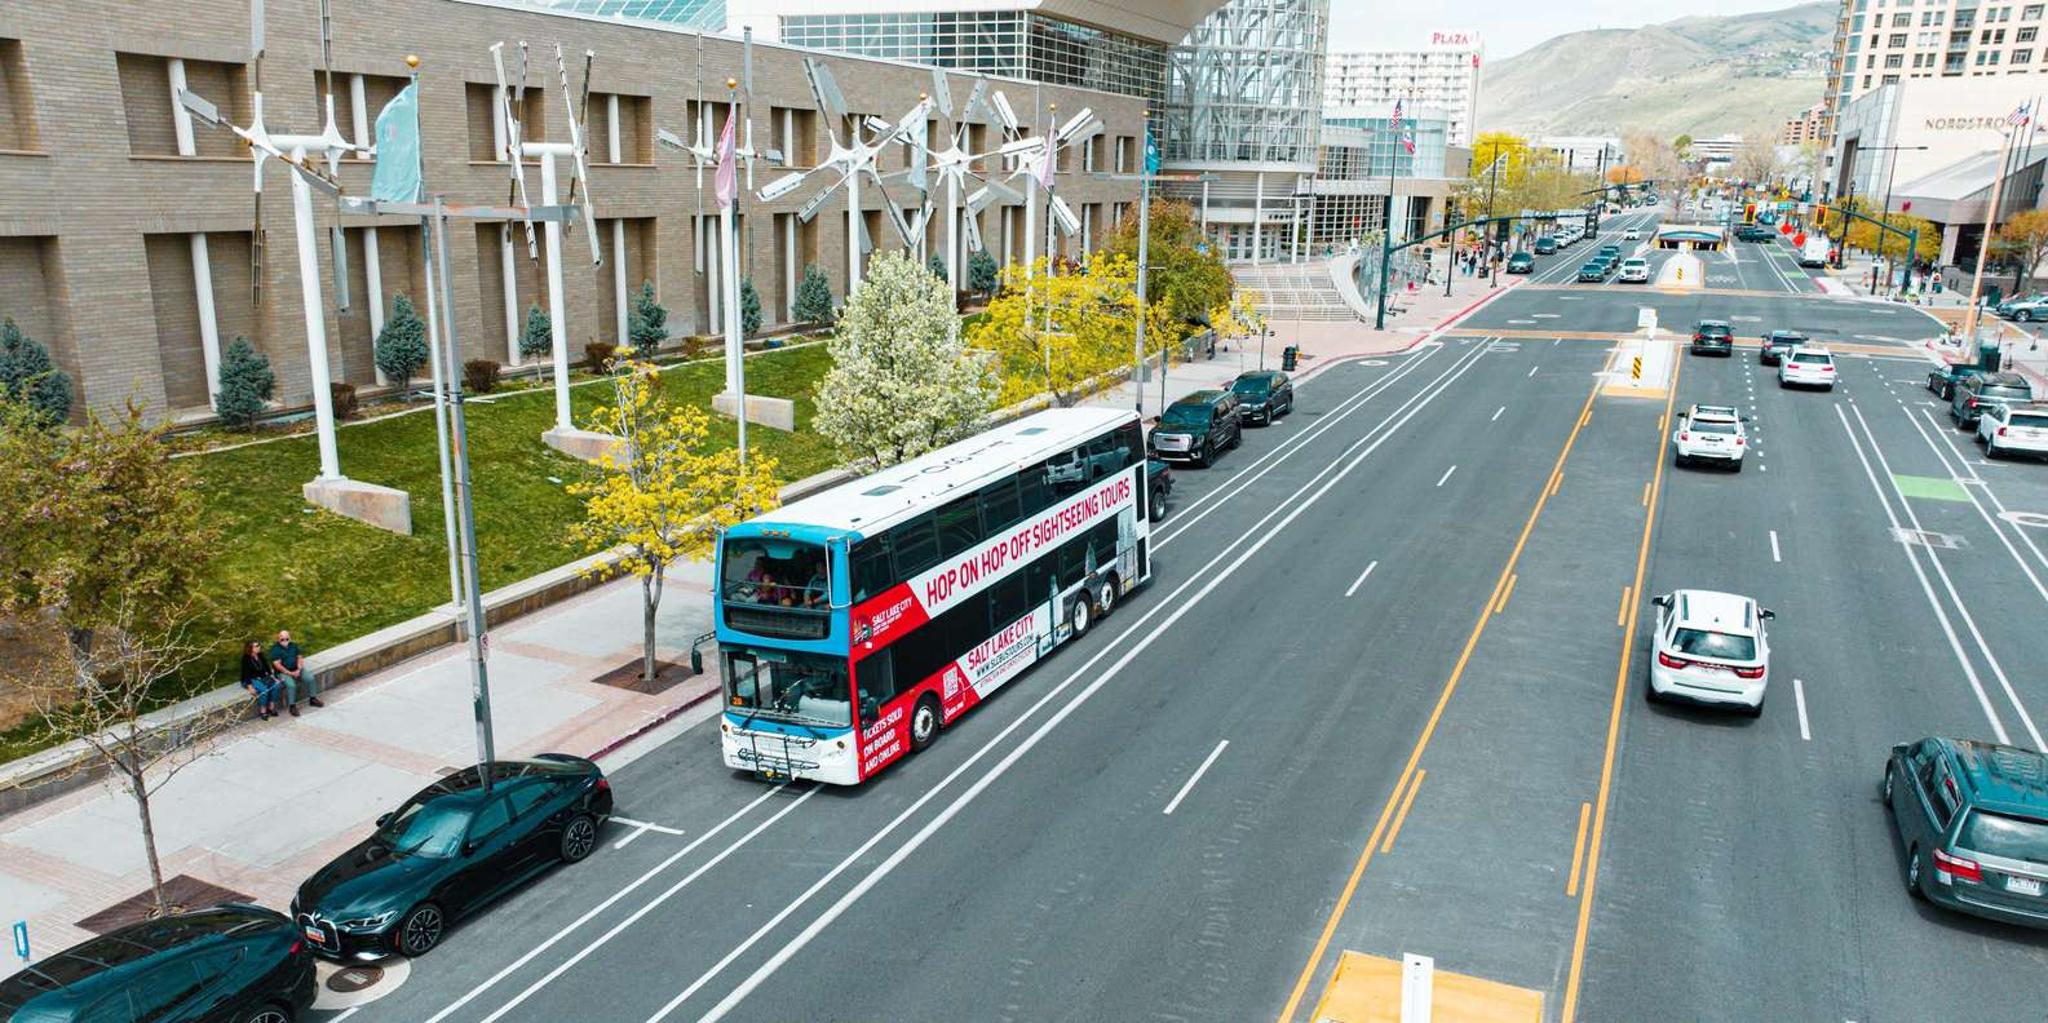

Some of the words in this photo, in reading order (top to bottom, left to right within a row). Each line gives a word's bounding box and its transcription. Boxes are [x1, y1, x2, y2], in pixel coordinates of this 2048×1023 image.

[1432, 31, 1469, 45] PLAZA
[1925, 117, 2013, 131] NORDSTRO
[926, 568, 957, 608] HOP
[960, 556, 979, 589] ON
[981, 541, 1008, 577] HOP
[1010, 529, 1031, 560] OFF
[1033, 494, 1099, 549] SIGHTSEEING
[1100, 477, 1130, 511] TOURS
[872, 609, 887, 627] SALT
[886, 602, 901, 620] LAKE
[900, 596, 913, 612] CITY
[967, 640, 991, 671] SALT
[991, 625, 1015, 655] LAKE
[1015, 613, 1035, 639] CITY
[863, 719, 887, 742] TICKETS
[886, 707, 903, 724] SOLD
[863, 743, 874, 757] ON
[873, 728, 896, 750] BOARD
[864, 757, 878, 773] AND
[876, 740, 901, 764] ONLINE
